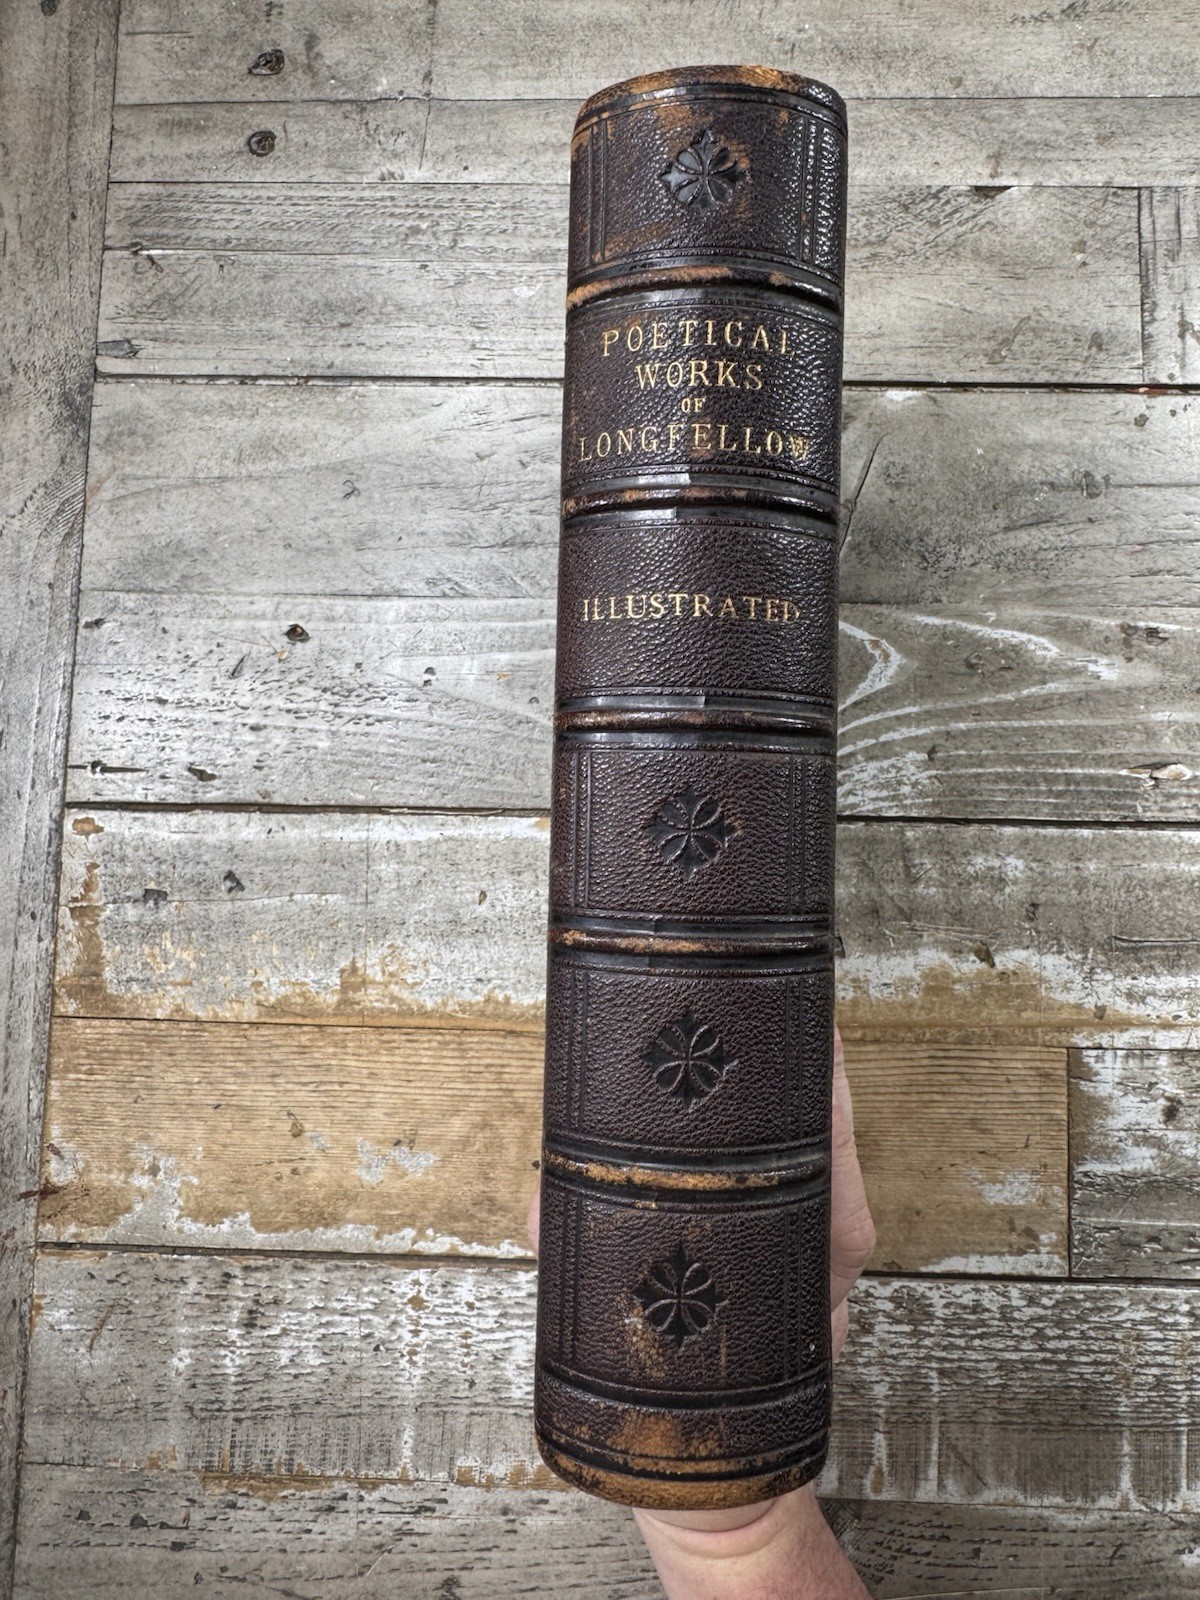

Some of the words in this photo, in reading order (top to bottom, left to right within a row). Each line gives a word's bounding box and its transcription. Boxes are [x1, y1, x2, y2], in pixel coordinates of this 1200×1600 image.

[601, 320, 795, 357] POETICAL
[635, 359, 763, 390] WORKS
[681, 397, 706, 413] OF
[579, 423, 809, 462] LONGFELLOW
[582, 594, 799, 622] ILLUSTRATED
